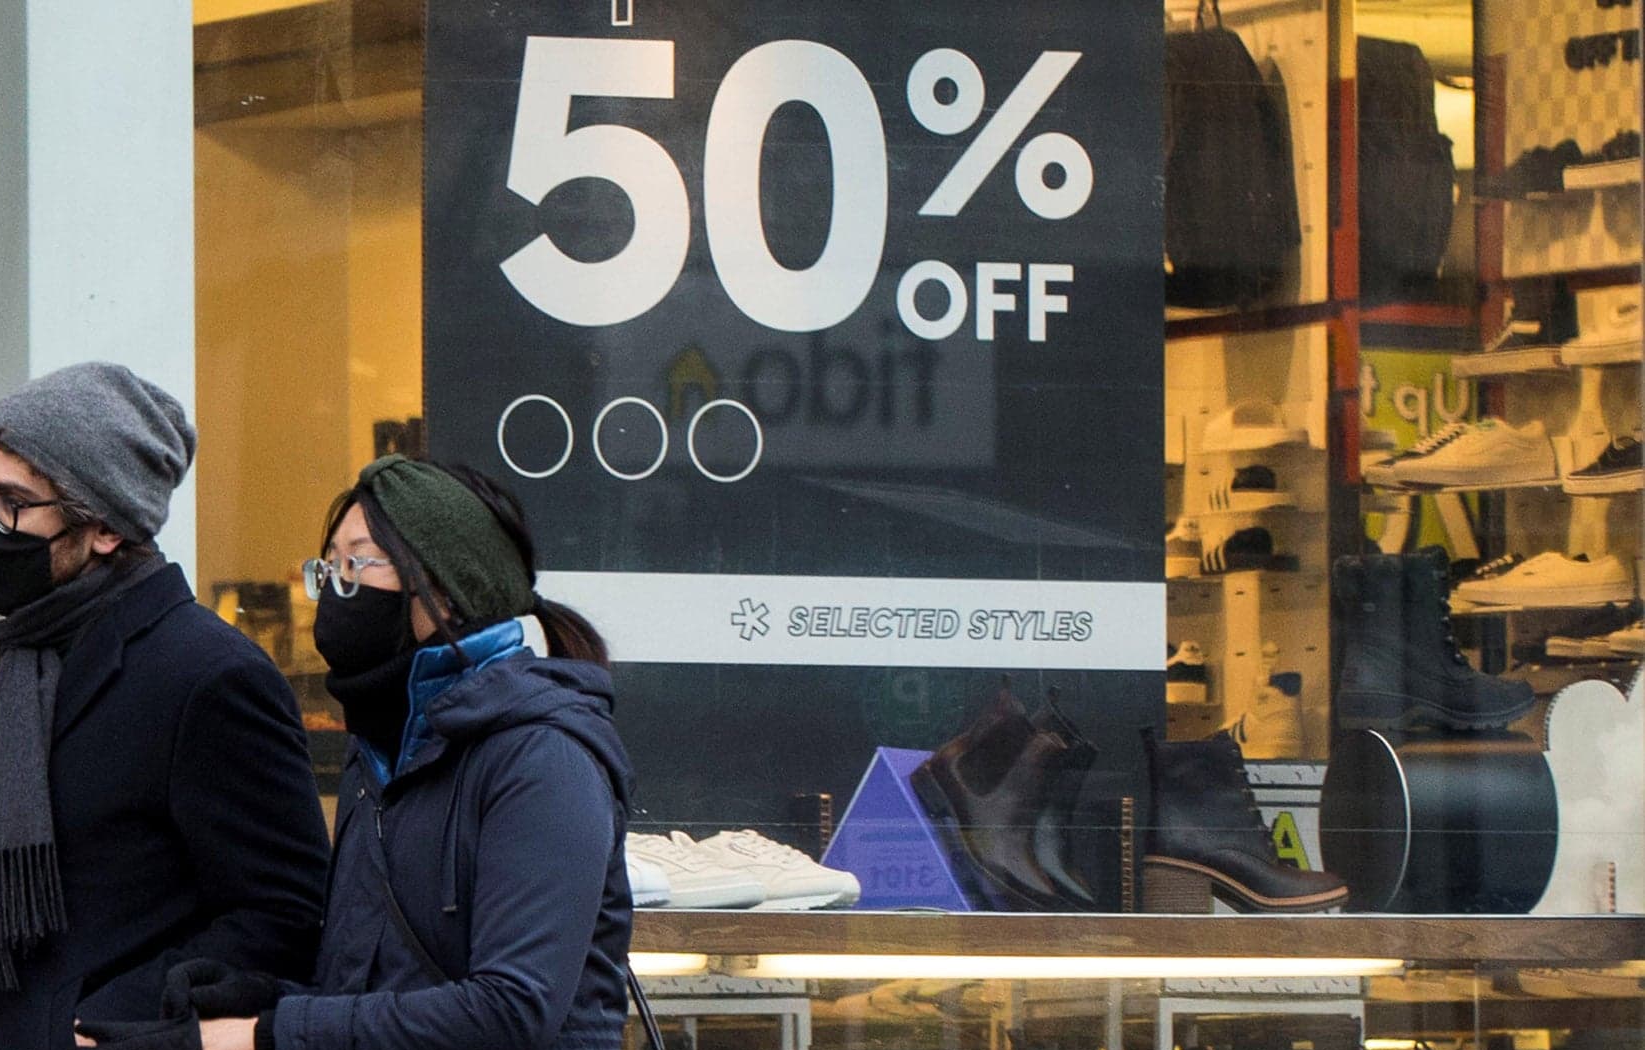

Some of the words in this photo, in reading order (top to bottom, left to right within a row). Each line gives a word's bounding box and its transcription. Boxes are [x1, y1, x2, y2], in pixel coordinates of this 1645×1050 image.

[499, 36, 1093, 332] 50%
[897, 260, 1074, 342] OFF
[787, 605, 960, 639] SELECTED
[967, 609, 1093, 641] STYLES
